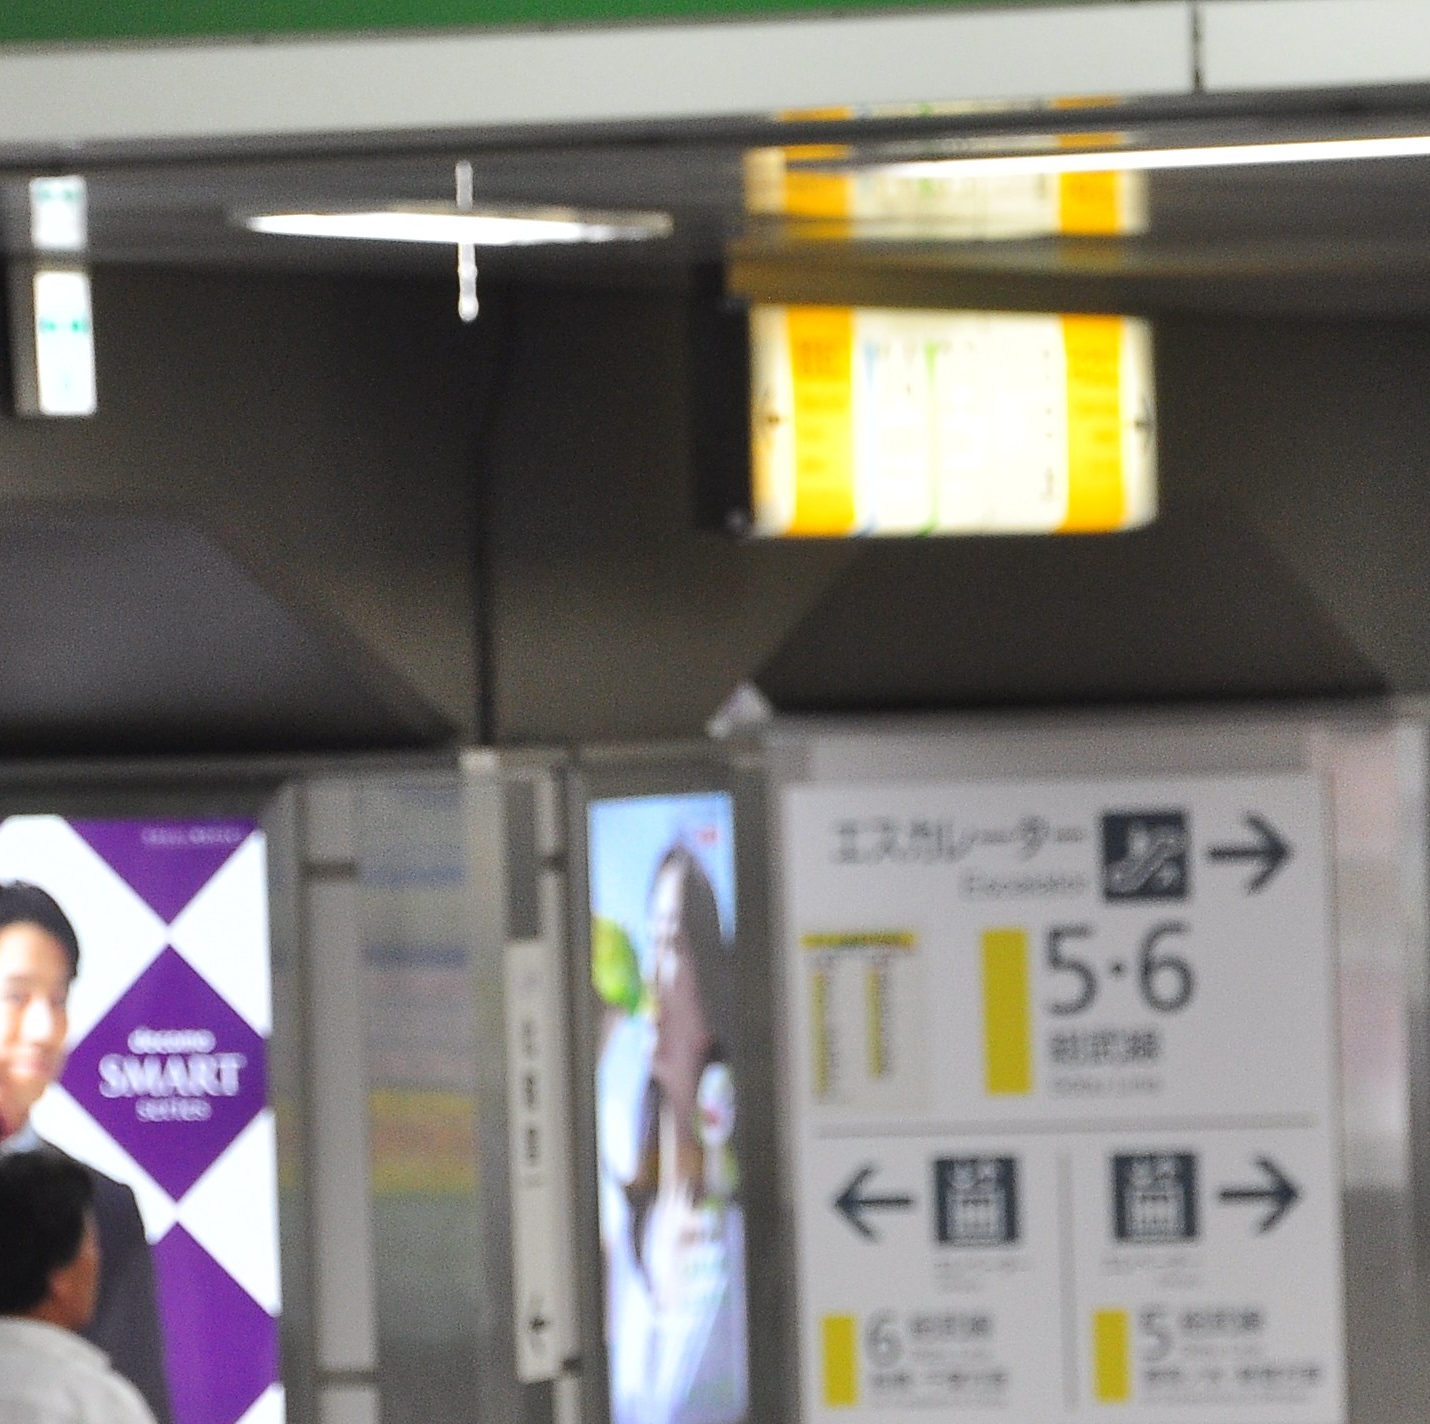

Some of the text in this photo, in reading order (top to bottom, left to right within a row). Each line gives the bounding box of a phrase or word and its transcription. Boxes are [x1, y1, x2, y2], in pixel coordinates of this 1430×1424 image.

[833, 814, 1086, 865] エスカレーター
[99, 1052, 247, 1098] SMART
